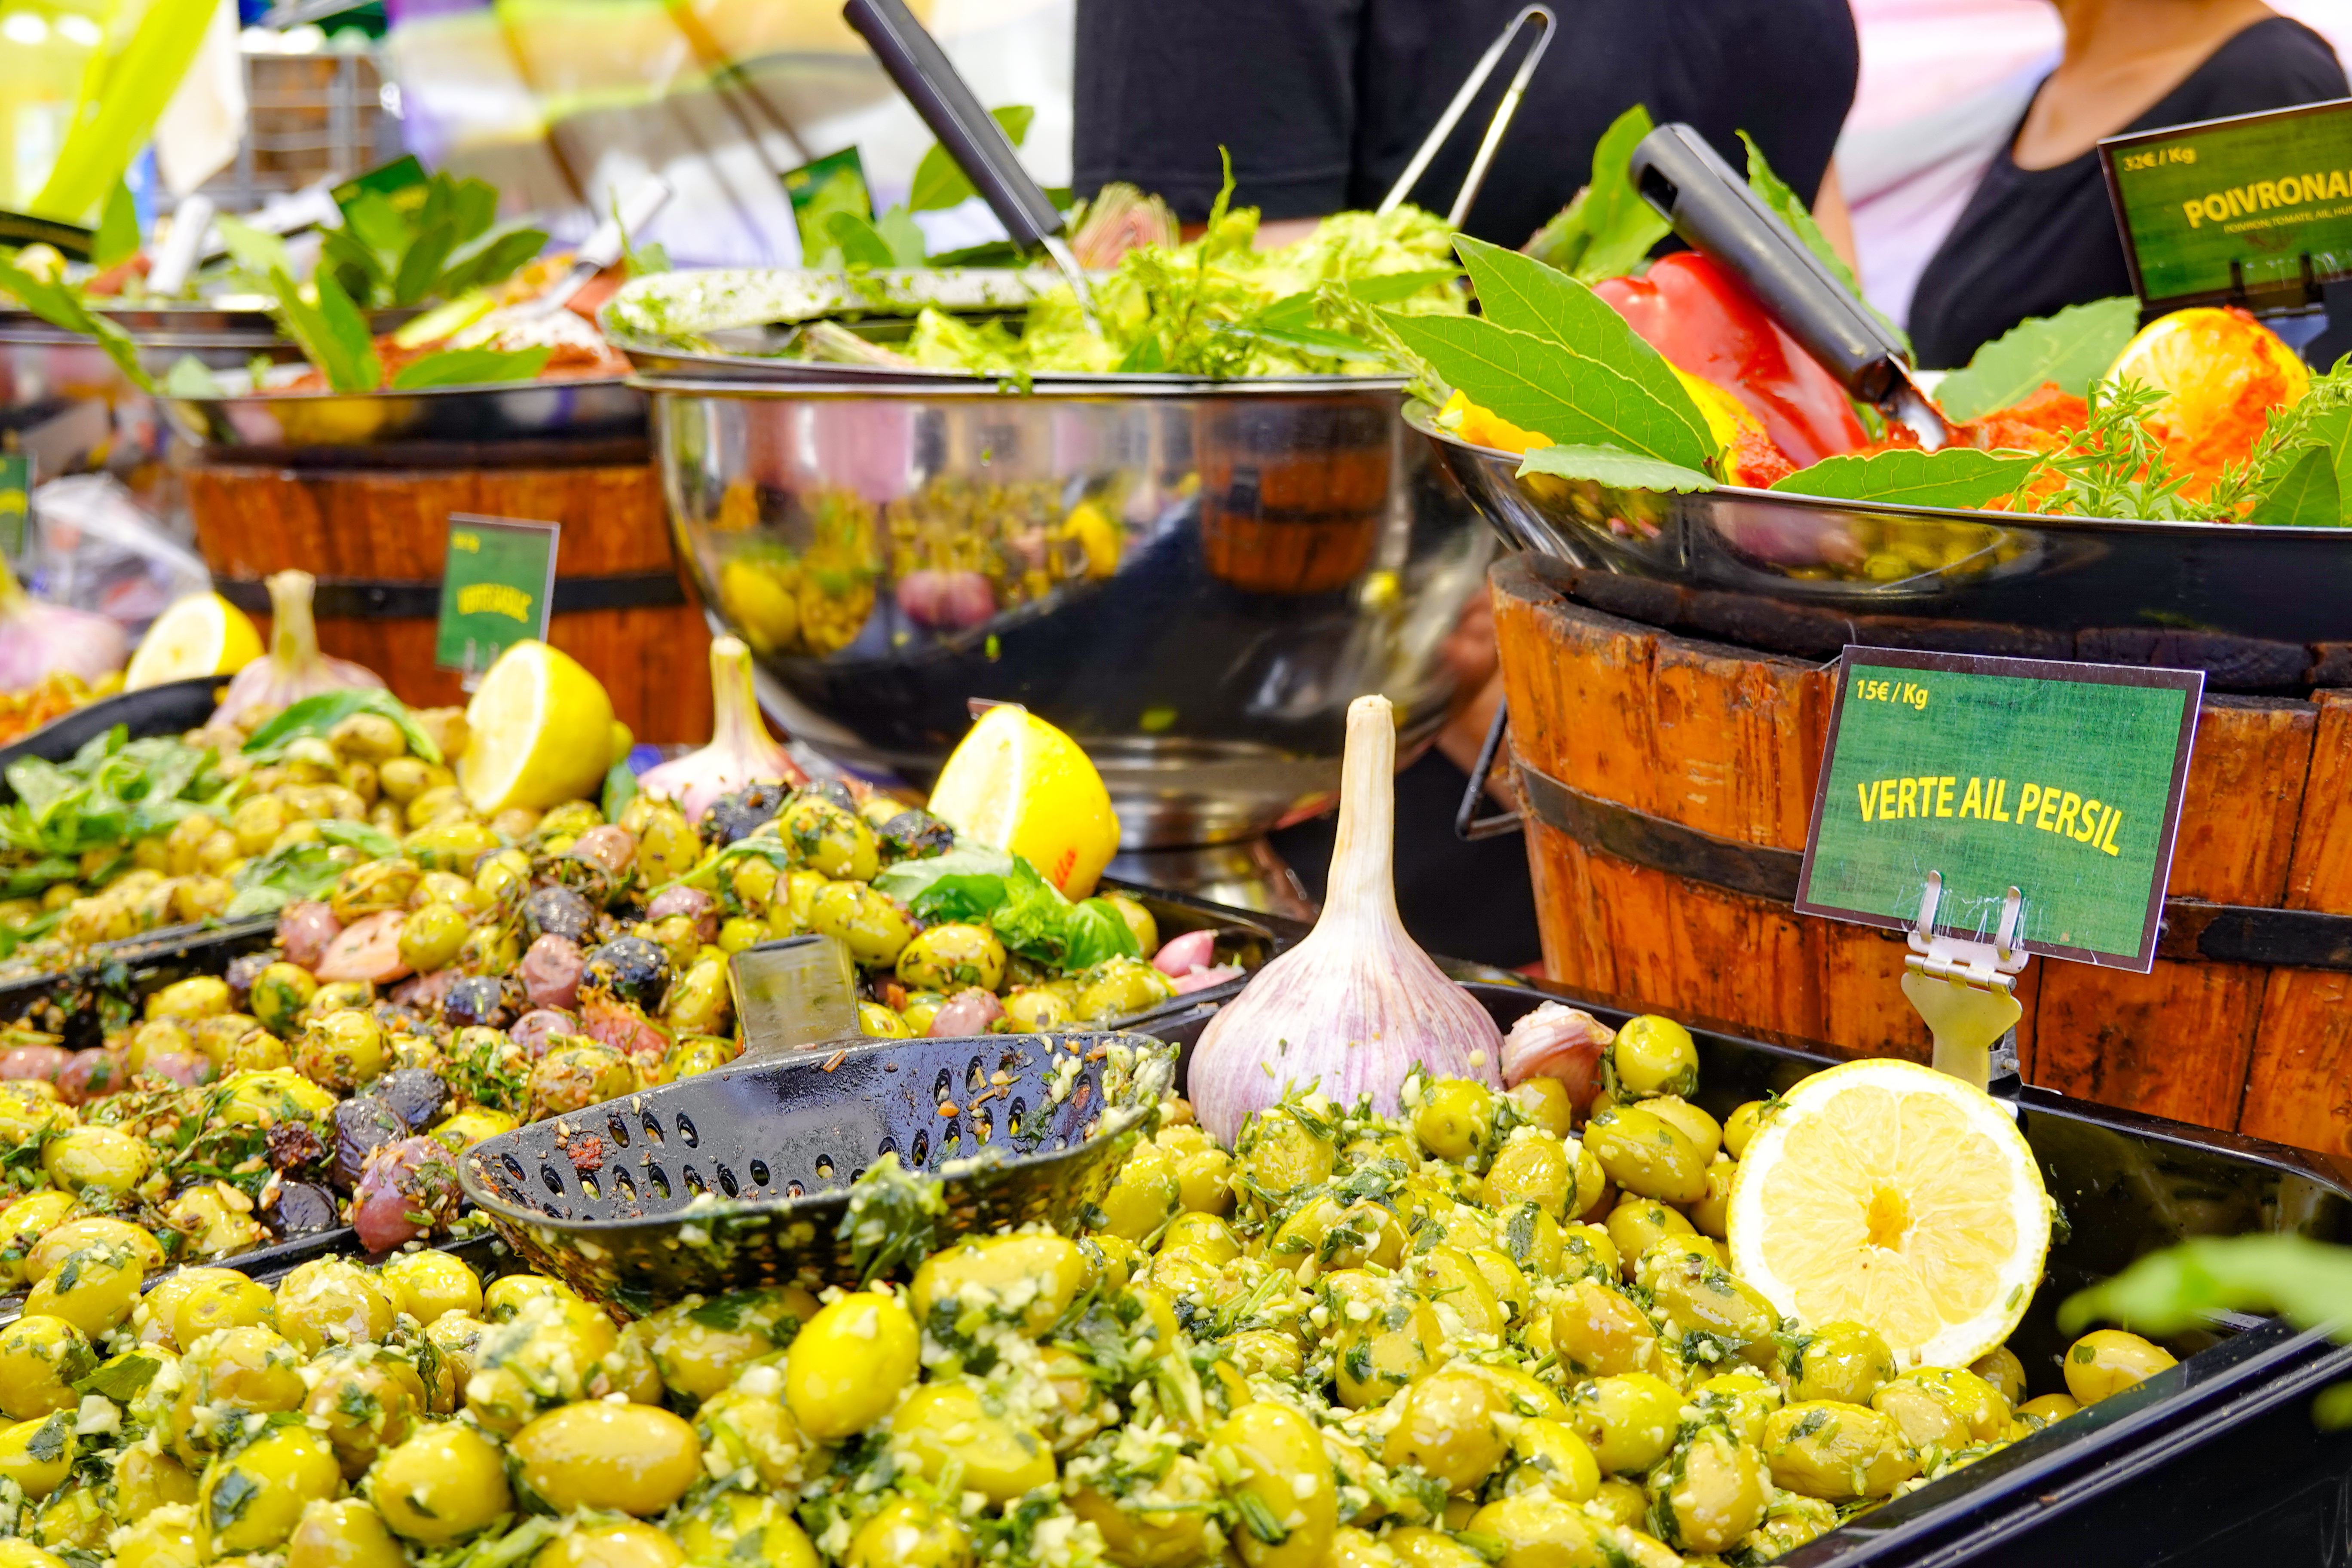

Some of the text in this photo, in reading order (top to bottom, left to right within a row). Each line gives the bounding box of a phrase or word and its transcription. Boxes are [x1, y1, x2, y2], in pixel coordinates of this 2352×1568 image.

[1857, 776, 2122, 857] VERTE AIL PERSIL
